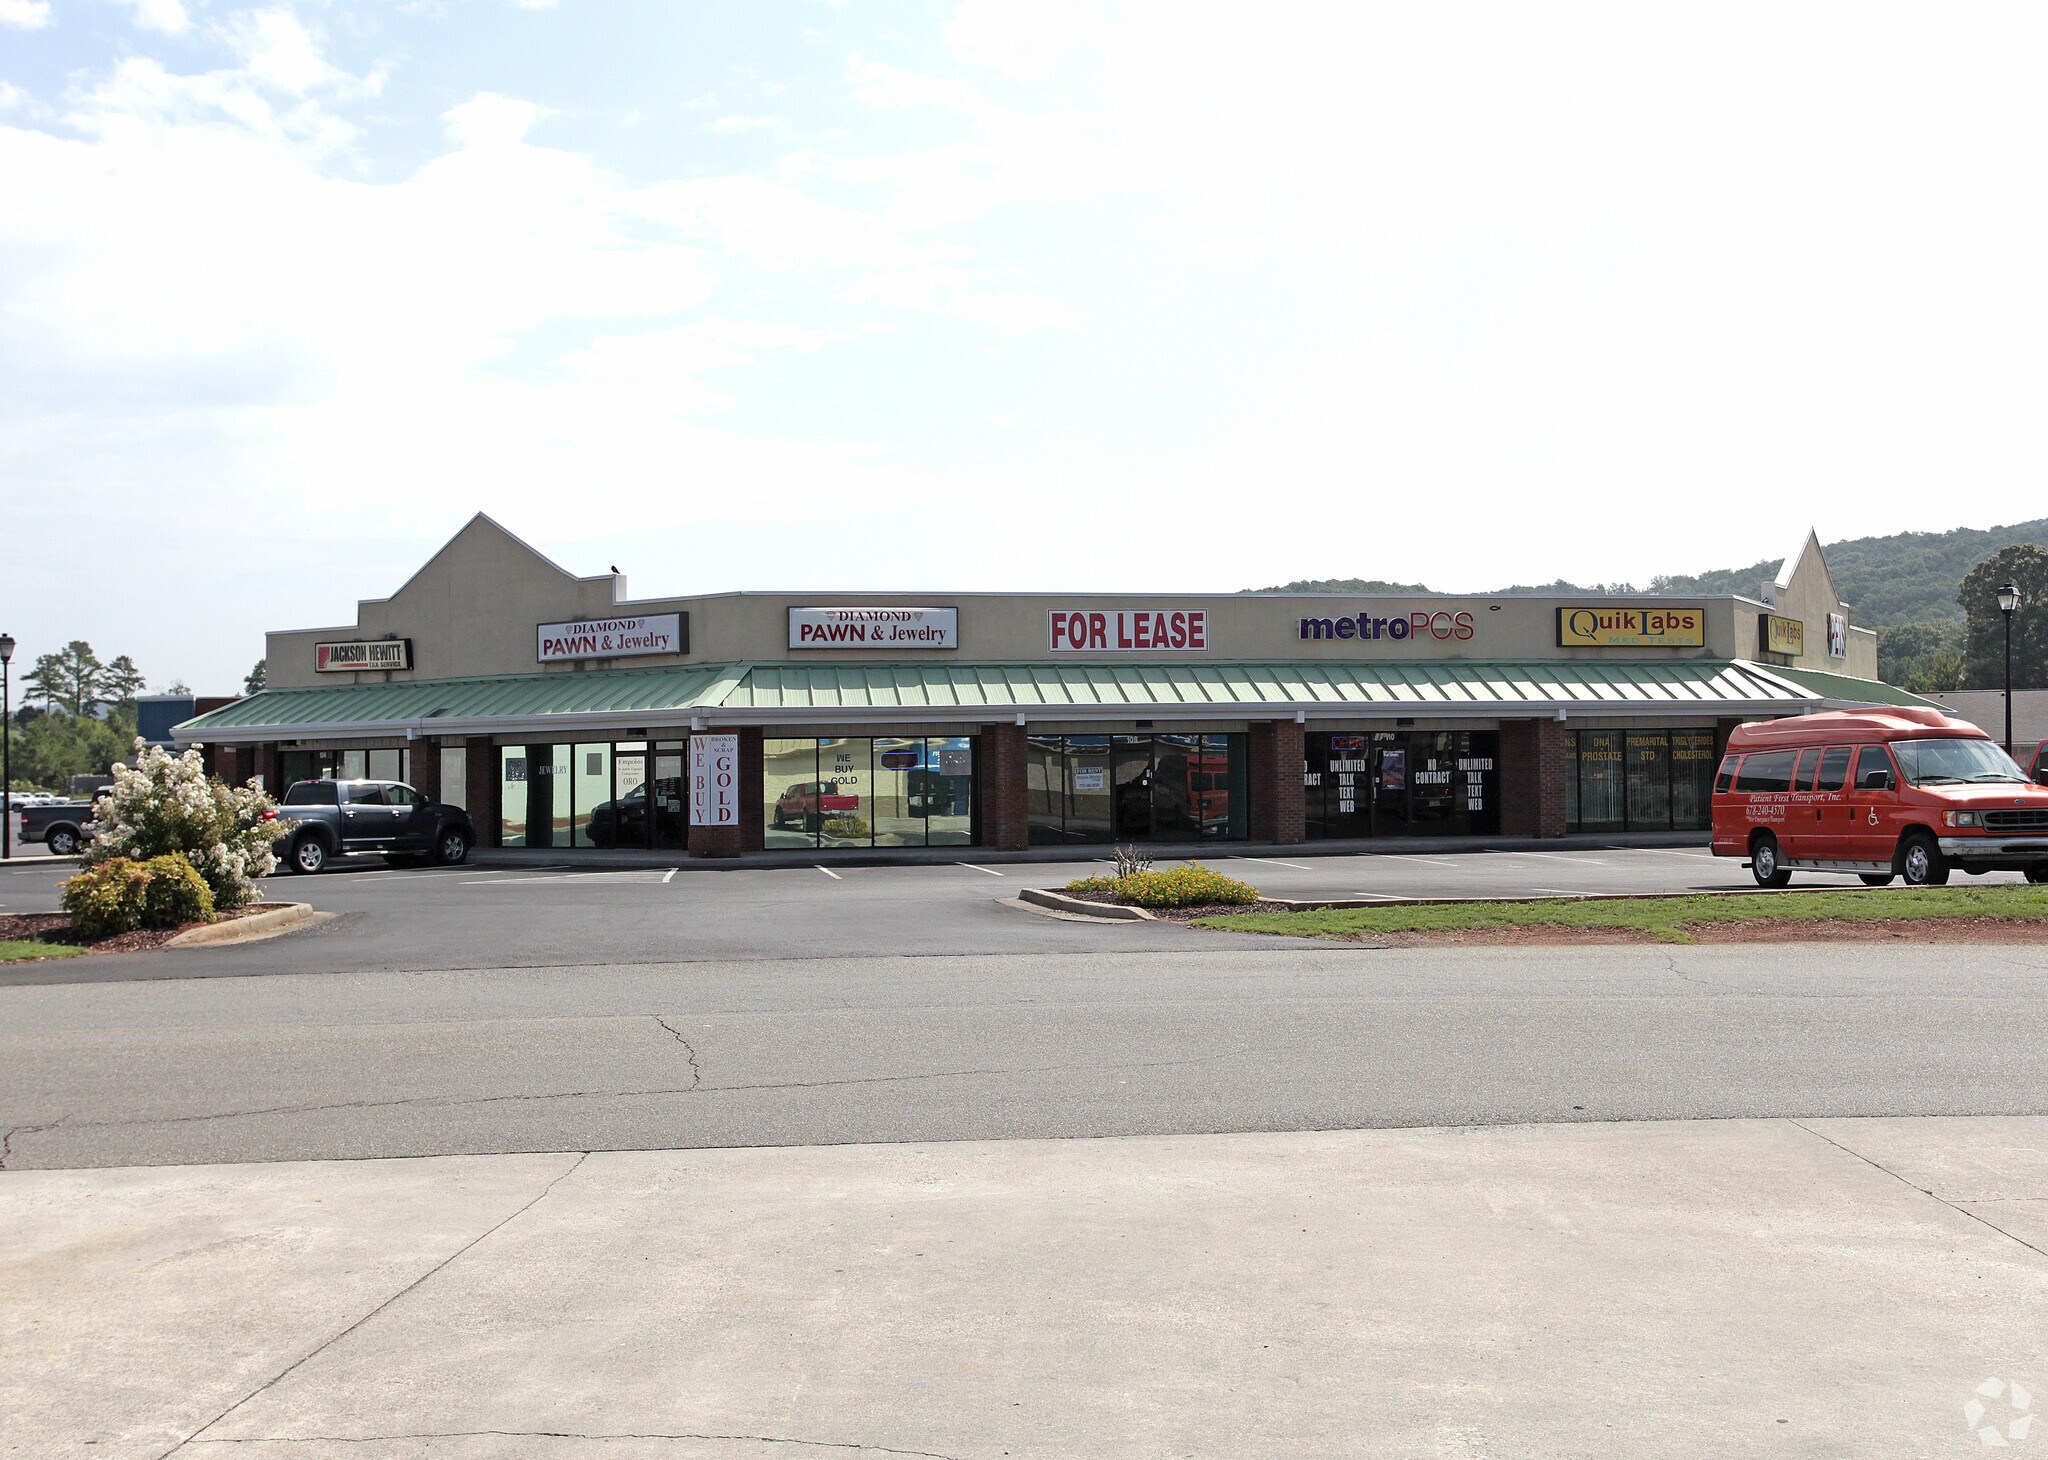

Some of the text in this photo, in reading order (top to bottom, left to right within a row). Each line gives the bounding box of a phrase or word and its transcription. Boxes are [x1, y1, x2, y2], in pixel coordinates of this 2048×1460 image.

[838, 611, 912, 622] DIAMOND
[573, 620, 636, 635] DIAMOND
[1051, 612, 1205, 649] FOR LEASE
[1300, 611, 1474, 640] metroPCS
[800, 624, 947, 645] PAWN & Jewelry
[543, 631, 670, 656] PAWN & Jewelry
[330, 644, 401, 662] JACKSON HEWITT
[1593, 737, 1610, 747] DNA
[1626, 736, 1669, 747] PREMARITAL
[1672, 736, 1714, 746] TRIGLYCERIDES
[693, 736, 708, 768] WE
[836, 754, 851, 762] WE
[1582, 751, 1622, 761] PROSTATE
[1640, 751, 1655, 761] STD
[1672, 750, 1713, 760] CHOLESTEROL
[539, 765, 568, 775] JEWELRY
[834, 765, 855, 773] BUY
[1330, 759, 1366, 772] UNLIMITED
[1427, 758, 1437, 771] NO
[1458, 758, 1493, 771] UNLIMITED
[623, 777, 638, 786] ORO
[831, 776, 858, 785] GOLD
[1339, 773, 1355, 786] TALK
[1415, 771, 1450, 784] CONTRACT
[1466, 771, 1482, 784] TALK
[716, 756, 732, 822] GOLD
[1338, 786, 1355, 799] TEXT
[1467, 784, 1483, 797] TEXT
[695, 775, 705, 824] BUY
[1749, 795, 1772, 803] Patient
[1773, 794, 1789, 803] First
[1827, 792, 1842, 801] Inc.
[1339, 800, 1355, 813] WEB
[1467, 798, 1483, 811] WEB
